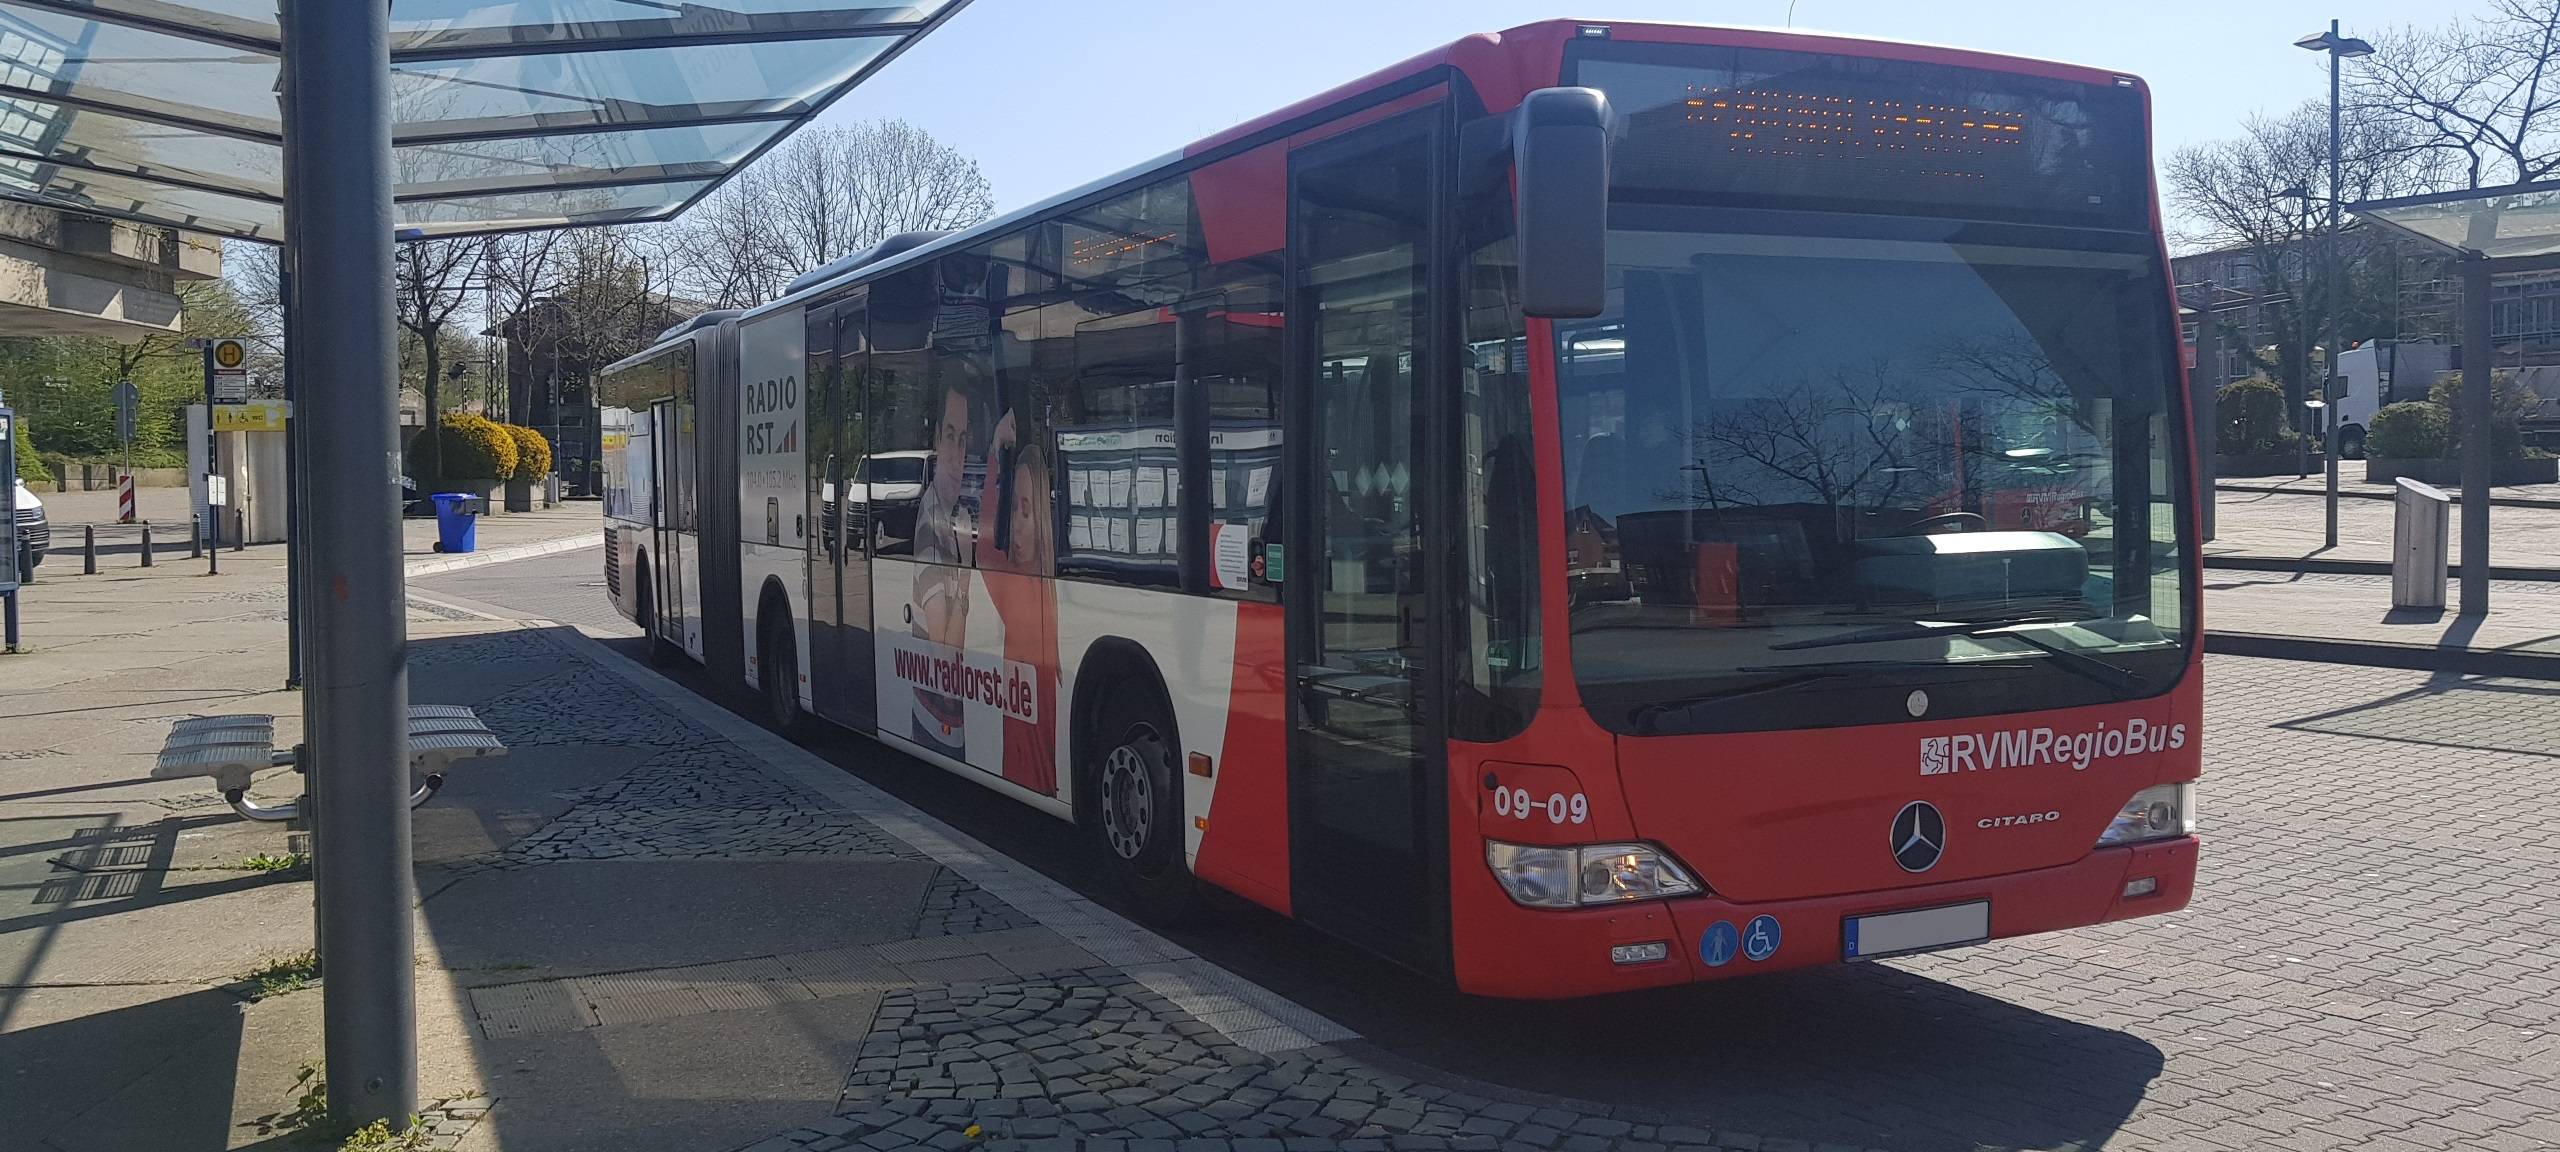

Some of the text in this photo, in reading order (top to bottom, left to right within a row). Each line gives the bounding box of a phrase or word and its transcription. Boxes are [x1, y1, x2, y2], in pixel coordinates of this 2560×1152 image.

[223, 346, 235, 362] H
[746, 375, 797, 416] RADIO
[746, 421, 774, 455] RST
[894, 647, 1032, 718] www.radiorst.de
[1951, 718, 2186, 772] RVMRegioBus
[1494, 785, 1588, 825] 09-09
[1977, 810, 2061, 829] CITARO
